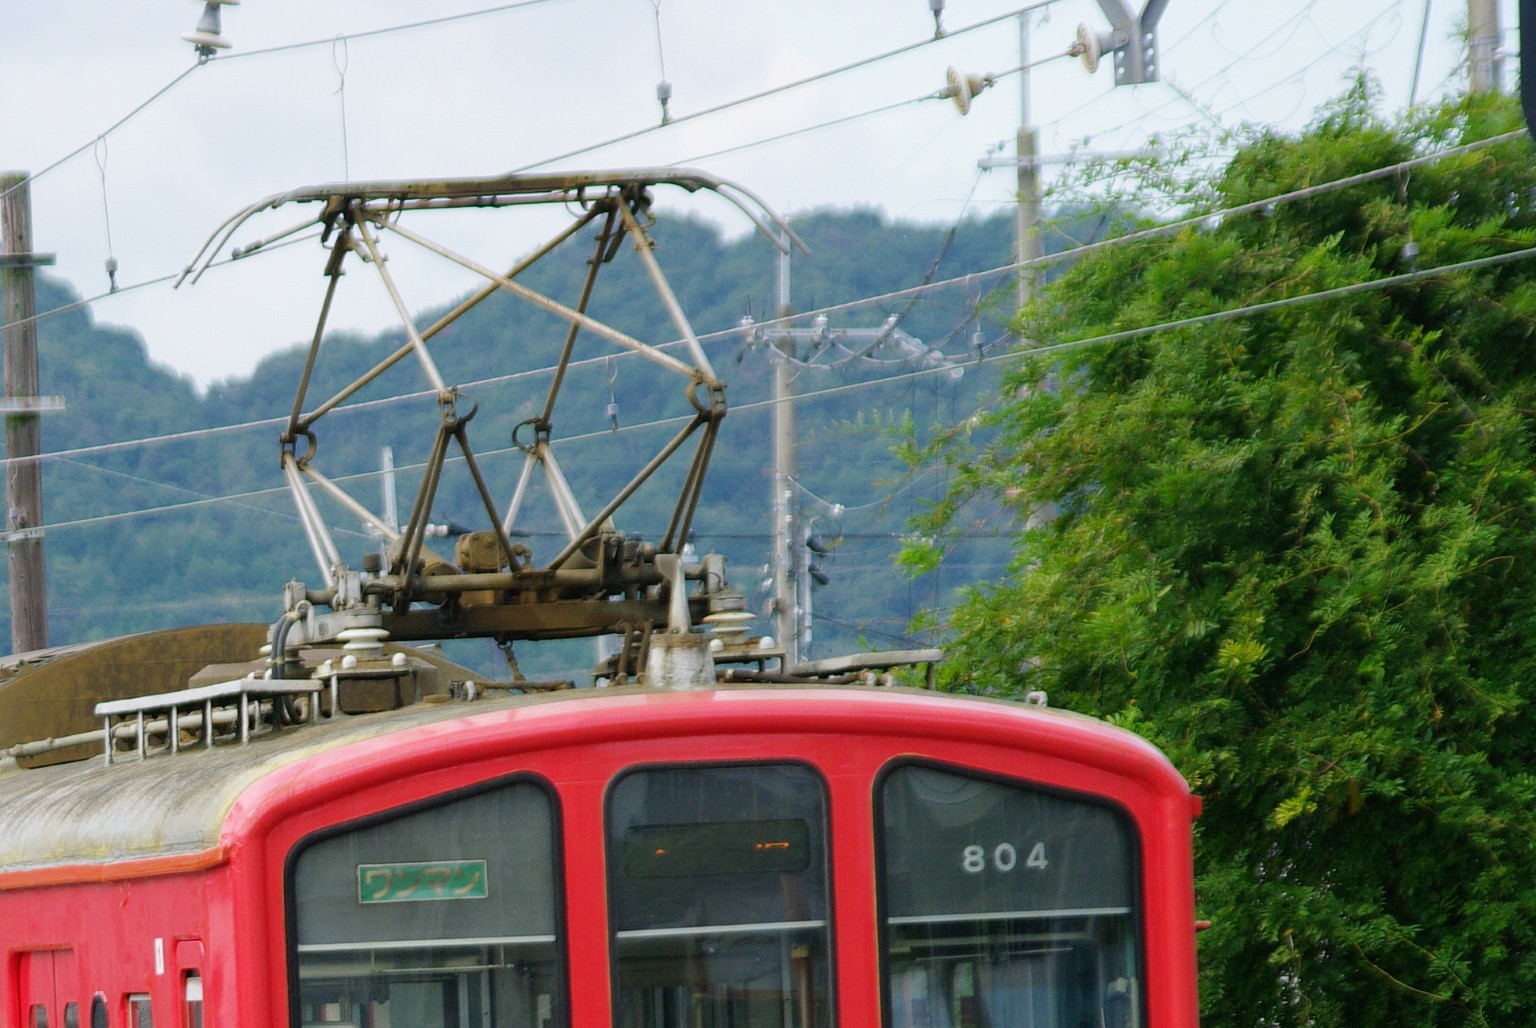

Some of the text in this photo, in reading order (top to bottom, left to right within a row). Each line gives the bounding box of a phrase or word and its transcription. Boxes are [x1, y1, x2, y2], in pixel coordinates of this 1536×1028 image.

[964, 842, 1049, 872] 804
[365, 866, 481, 899] ワンマン
